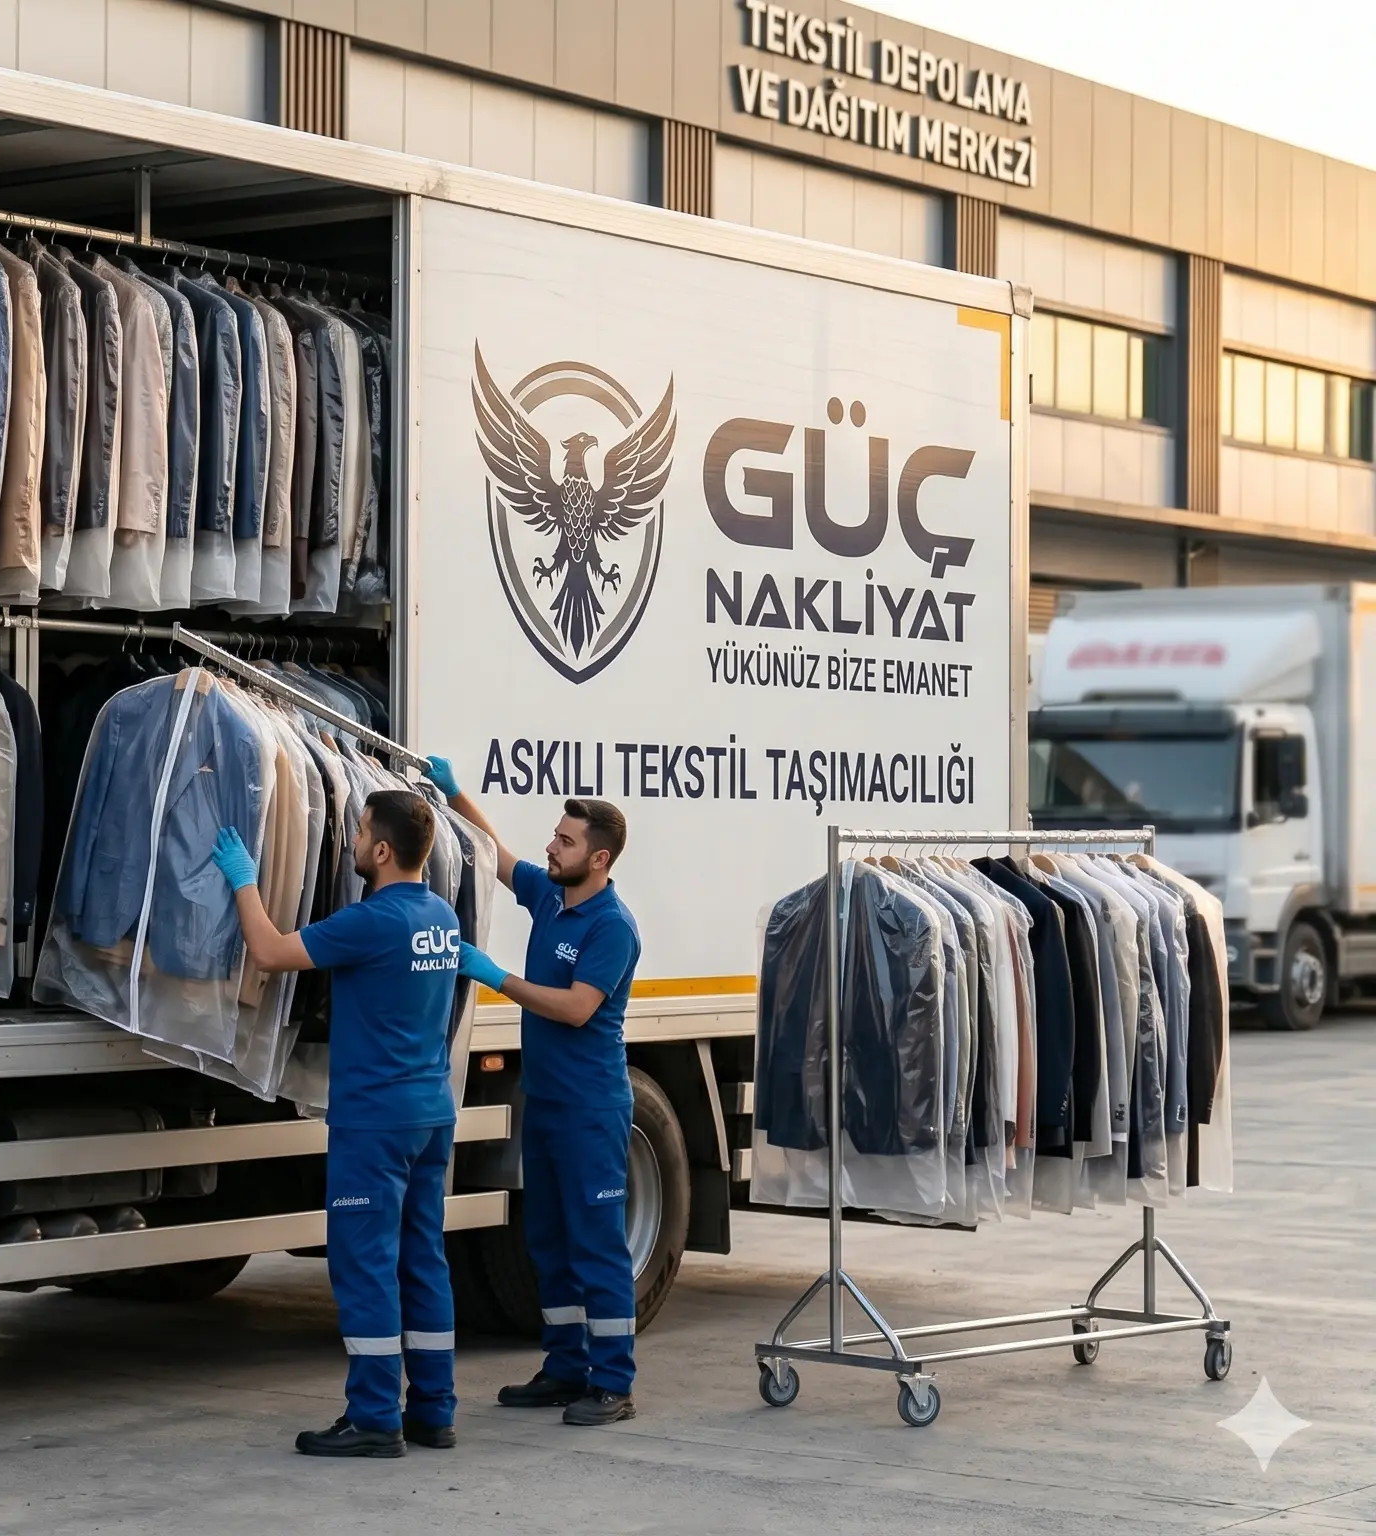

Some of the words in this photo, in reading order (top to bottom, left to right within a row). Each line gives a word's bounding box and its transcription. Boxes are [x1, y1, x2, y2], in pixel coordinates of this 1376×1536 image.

[745, 0, 872, 79] TEKSTİL
[880, 39, 1032, 125] DEPOLAMA
[738, 64, 780, 119] VE
[787, 76, 911, 155] DAĞITIM
[919, 115, 1037, 188] MERKEZİ
[702, 396, 976, 580] GÜÇ
[706, 568, 977, 643] NAKLİYAT
[706, 640, 821, 690] YÜKÜNÜZ
[827, 647, 877, 693] BİZE
[883, 659, 973, 698] EMANET
[480, 738, 603, 796] ASKILI
[614, 733, 758, 800] TEKSTİL
[765, 742, 974, 817] TAŞIMACILIĞI
[411, 925, 460, 958] GÜÇ
